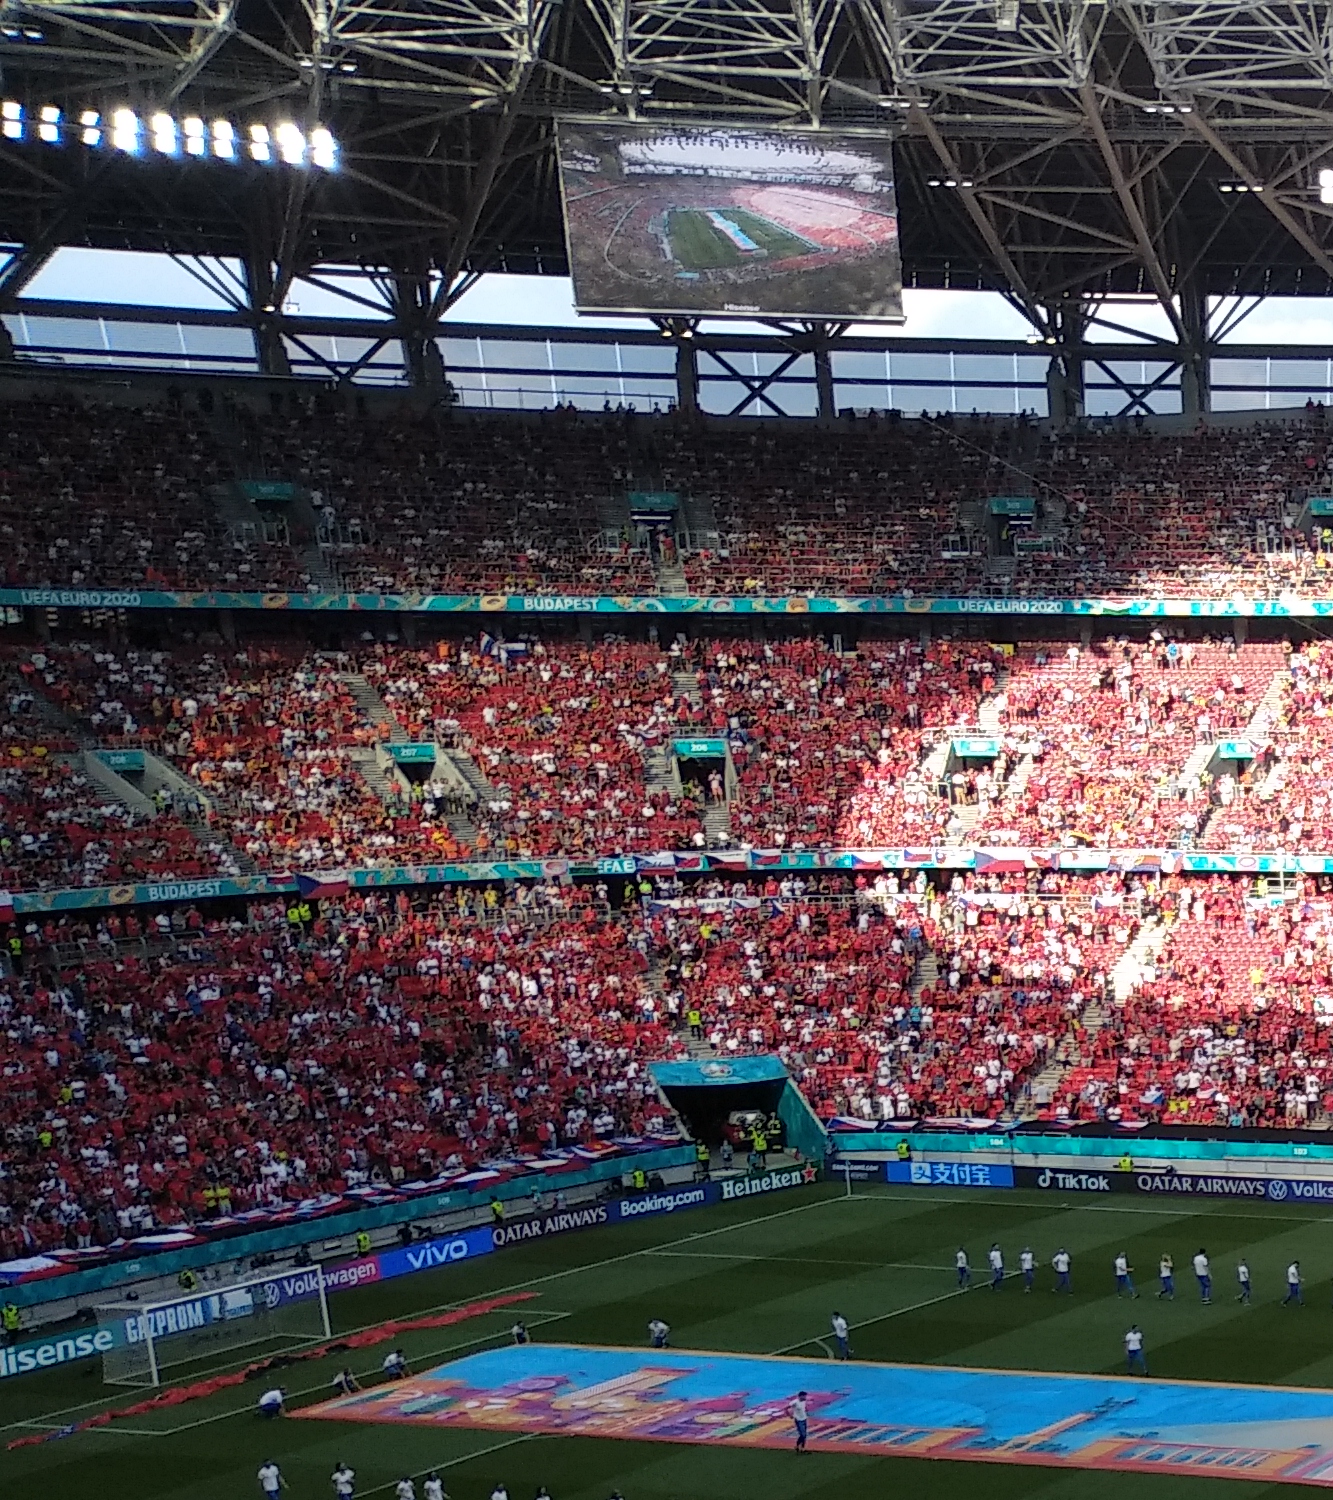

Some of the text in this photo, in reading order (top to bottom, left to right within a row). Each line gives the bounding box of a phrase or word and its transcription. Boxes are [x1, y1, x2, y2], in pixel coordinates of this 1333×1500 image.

[21, 591, 60, 605] UEFA
[523, 598, 600, 611] BUDAPEST
[958, 600, 994, 612] UEFA
[147, 881, 221, 900] BUDAPEST
[722, 1170, 803, 1200] Heineken
[931, 1164, 992, 1186] 支付宝
[1056, 1173, 1110, 1191] TikTok
[1137, 1175, 1266, 1196] QATAR AIRWAYS
[620, 1188, 705, 1218] Booking.com
[492, 1207, 608, 1247] QATAR AIRWAYS
[405, 1239, 468, 1269] vivo
[125, 1300, 205, 1343] GAZPROM
